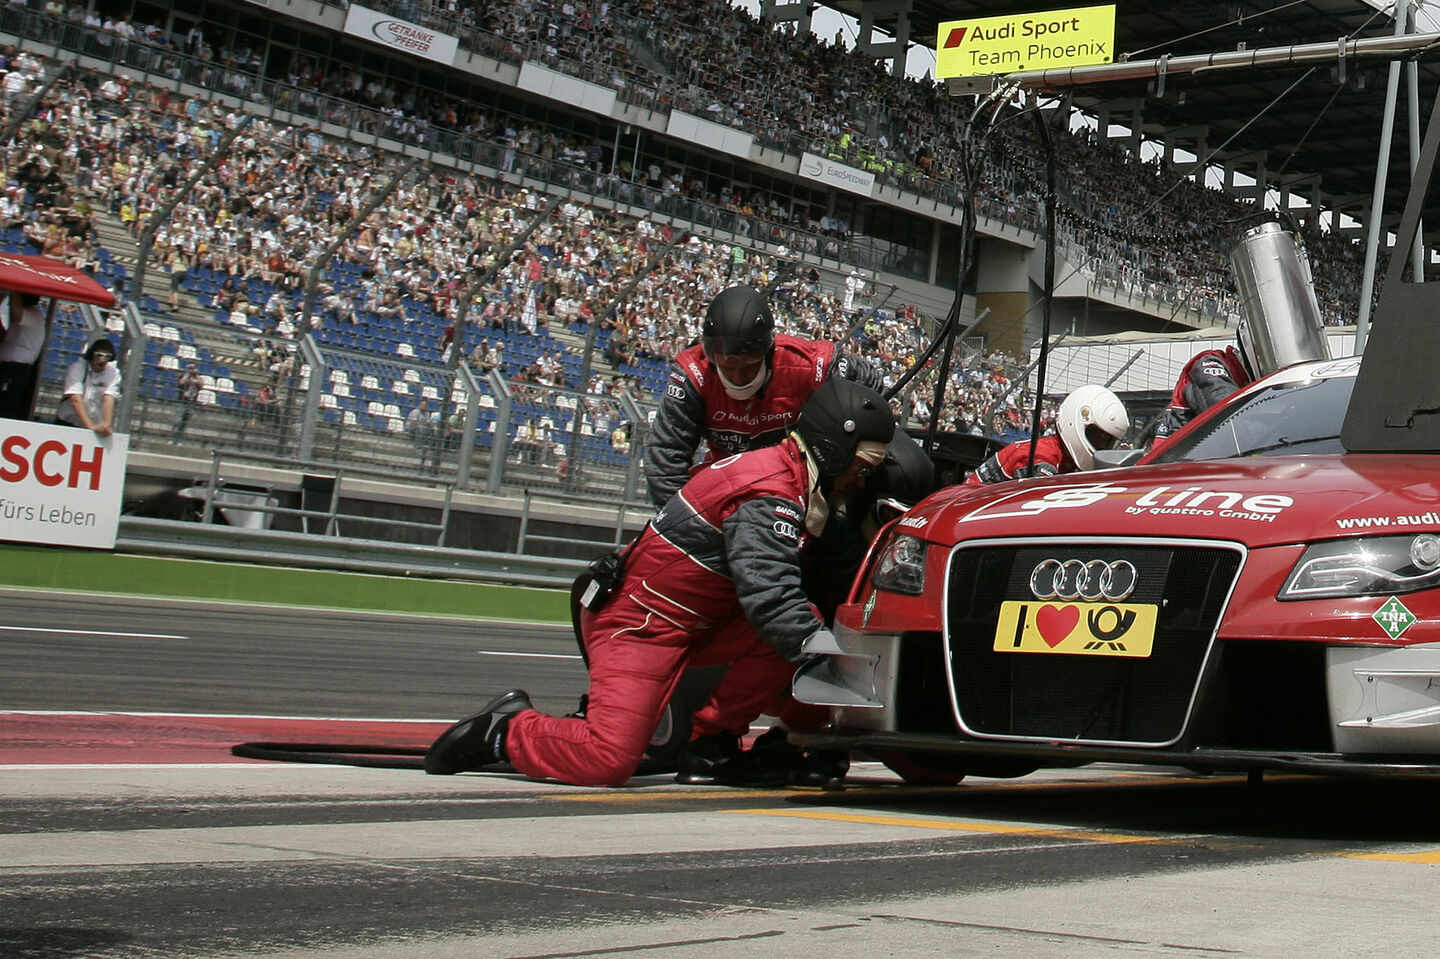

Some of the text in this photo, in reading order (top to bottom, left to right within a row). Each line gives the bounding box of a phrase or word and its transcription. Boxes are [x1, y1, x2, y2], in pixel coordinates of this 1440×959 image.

[969, 17, 1080, 41] Audi Sport
[396, 34, 431, 53] PFEIFER
[969, 39, 1106, 66] Team Phoenix
[761, 411, 793, 422] Sport
[0, 435, 104, 491] SCH
[1135, 486, 1296, 514] line
[39, 504, 95, 527] Leben
[1125, 506, 1277, 523] by quattro GmbH
[1013, 605, 1028, 648] I
